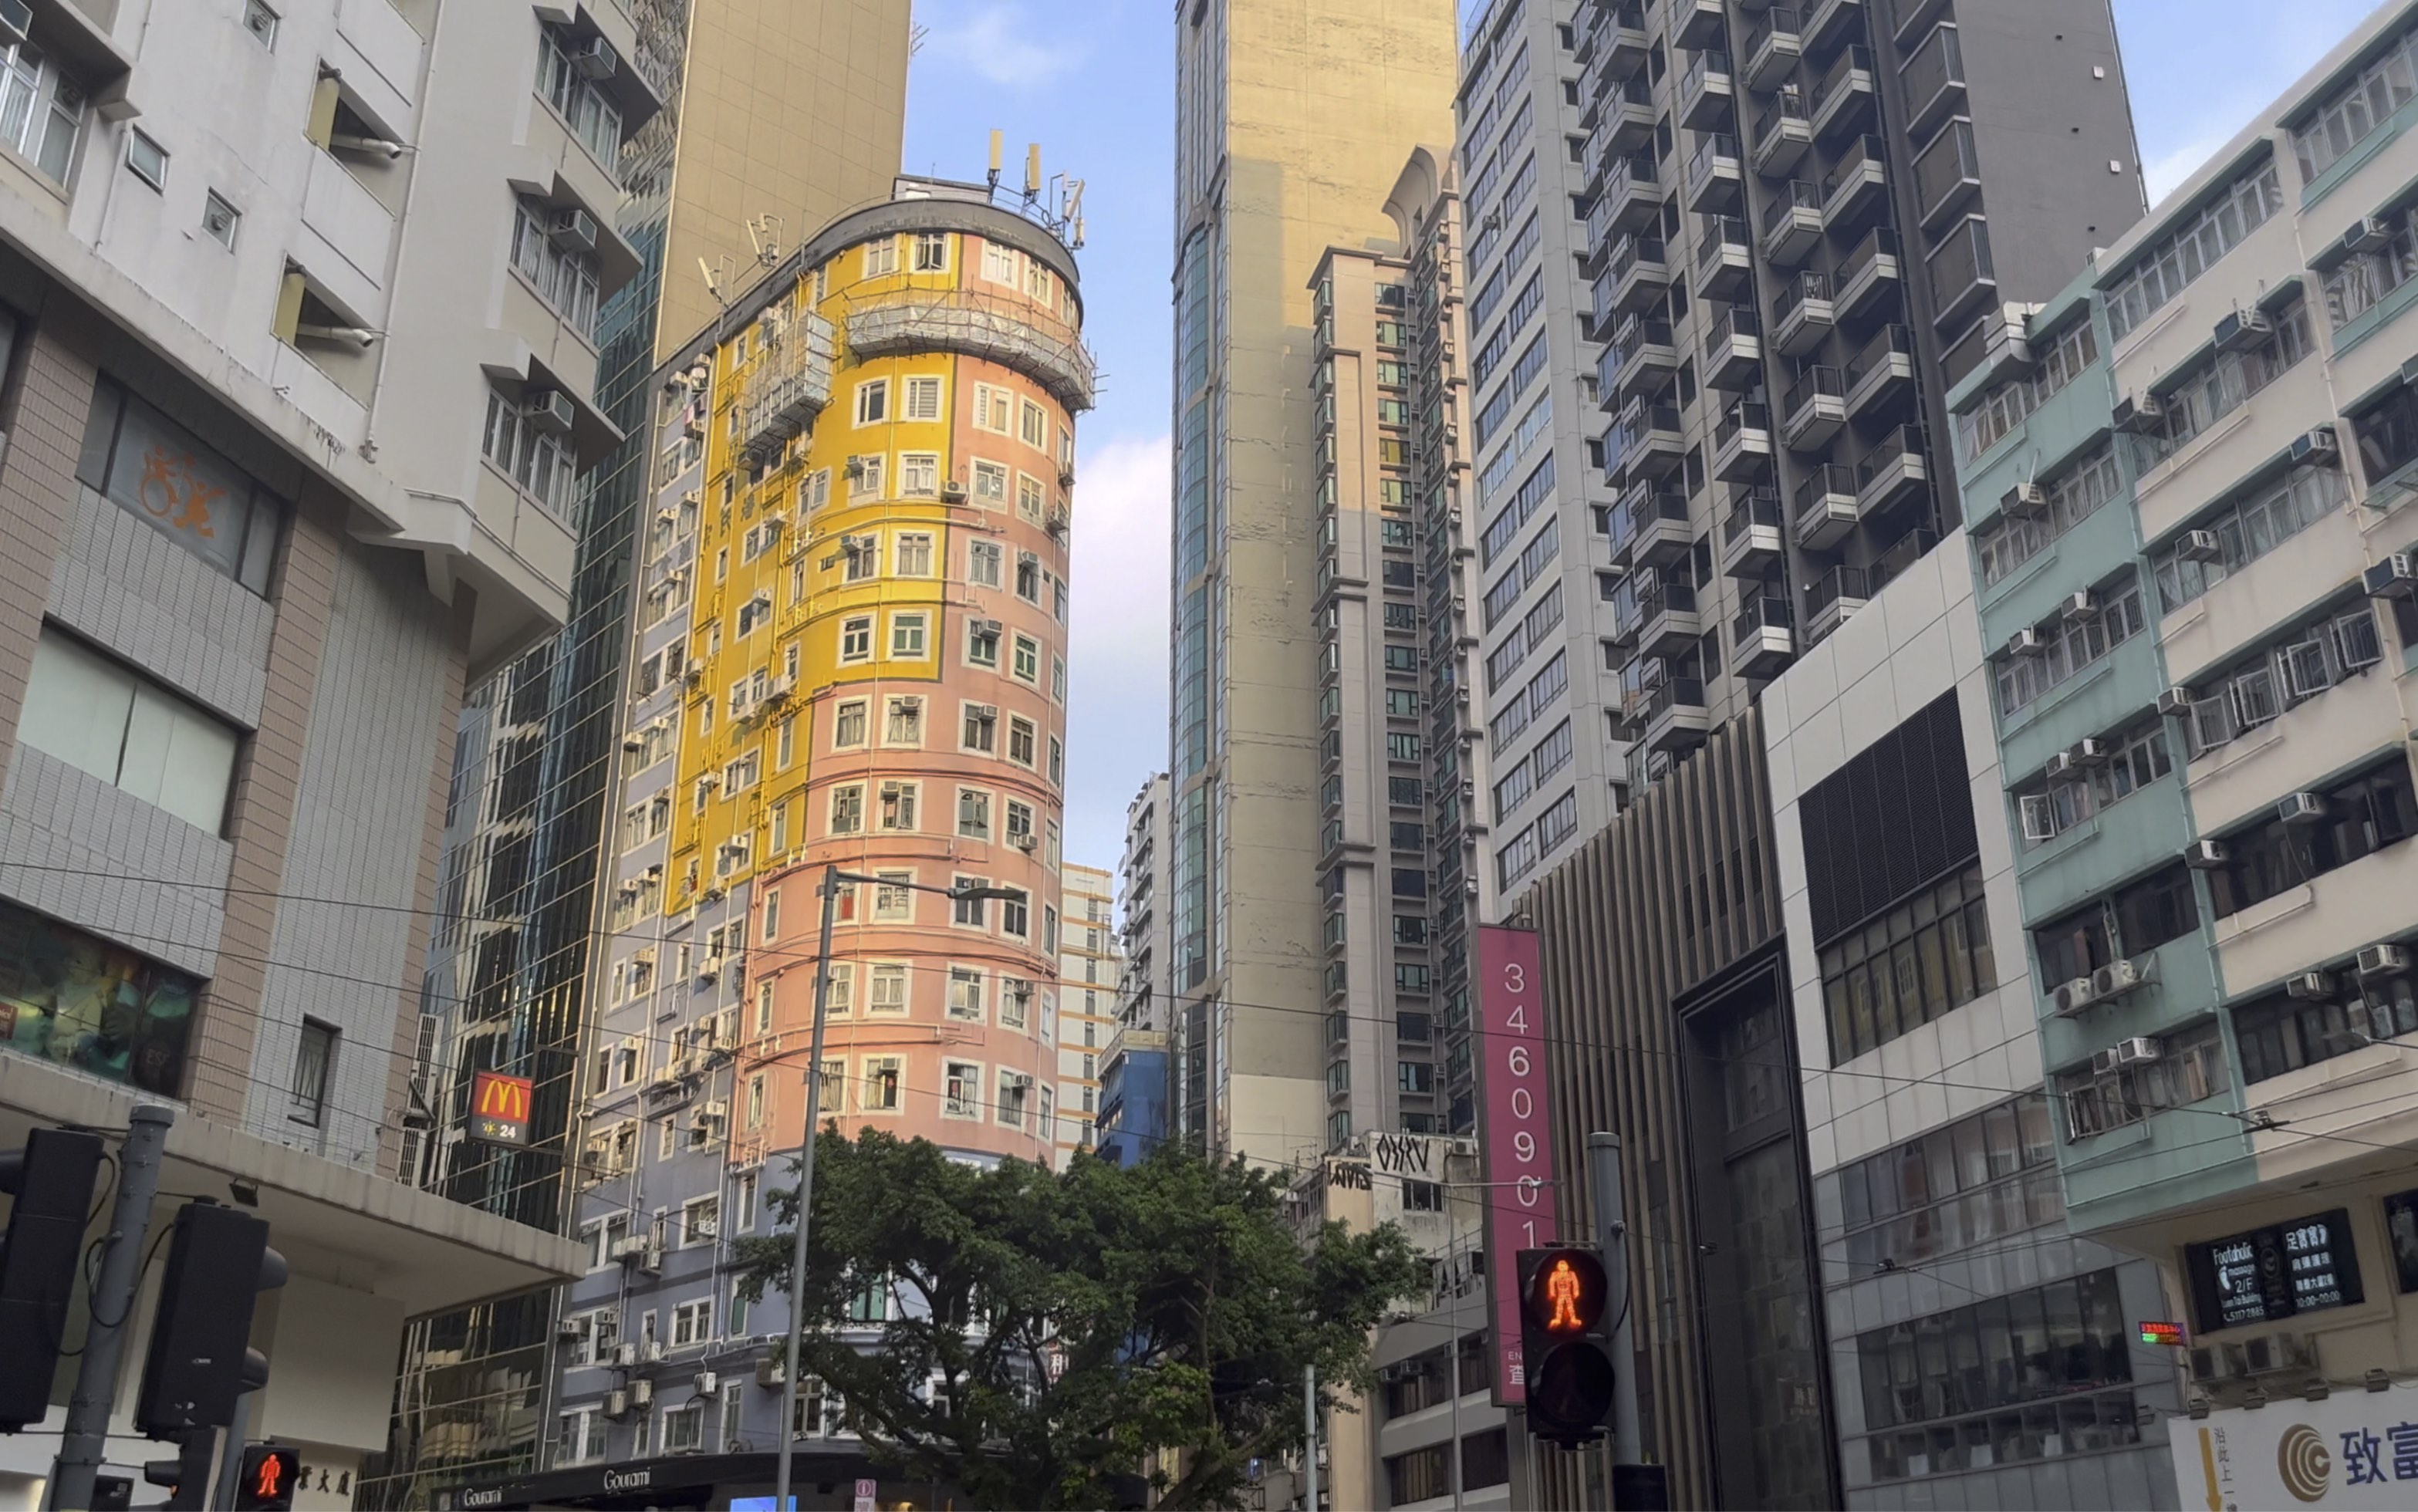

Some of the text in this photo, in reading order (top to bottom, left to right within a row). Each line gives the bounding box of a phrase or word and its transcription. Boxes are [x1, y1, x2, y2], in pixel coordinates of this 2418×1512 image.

[499, 1124, 516, 1138] 24
[2213, 1242, 2253, 1265] Footaholic
[2235, 1277, 2253, 1293] 2/F
[2230, 1309, 2245, 1321] 5117
[2339, 1422, 2418, 1486] 致富
[604, 1466, 650, 1490] Gourami
[464, 1486, 502, 1506] Gourami
